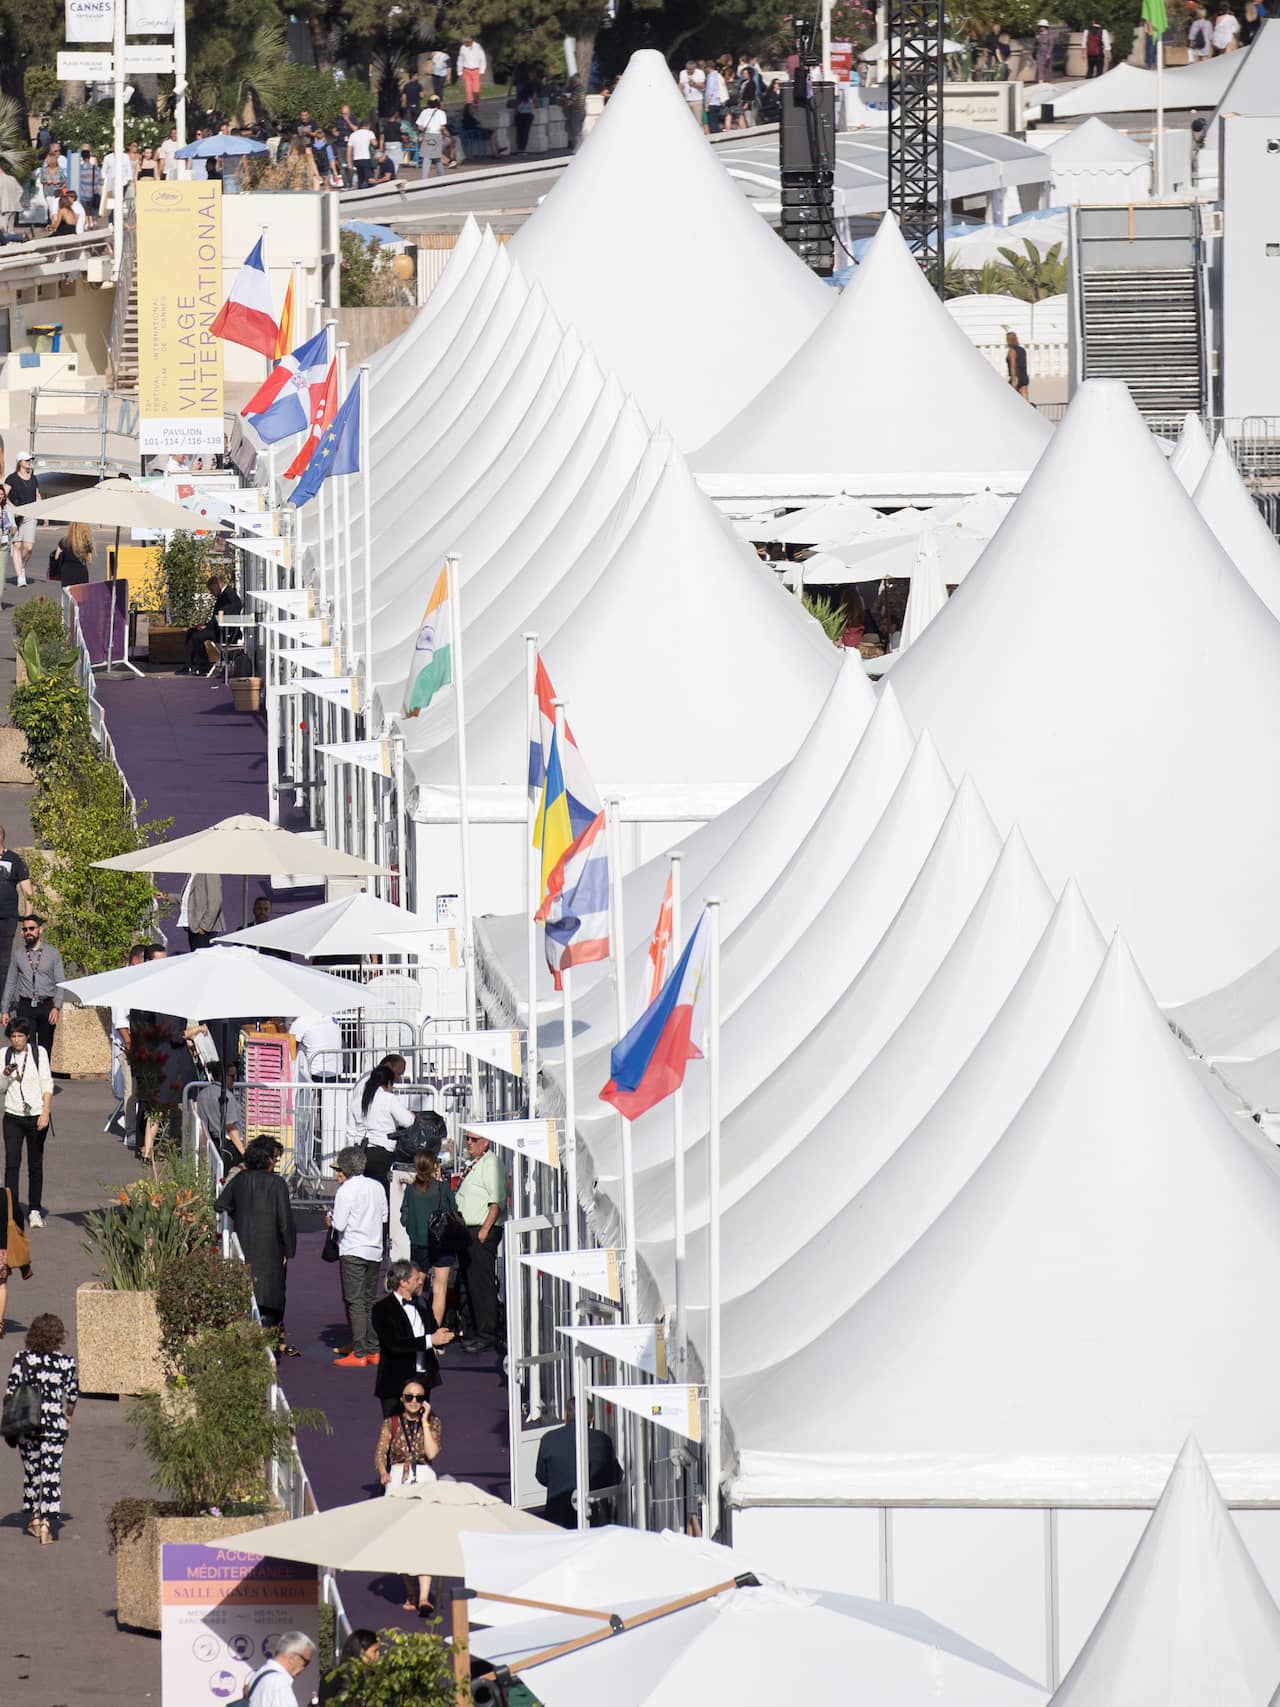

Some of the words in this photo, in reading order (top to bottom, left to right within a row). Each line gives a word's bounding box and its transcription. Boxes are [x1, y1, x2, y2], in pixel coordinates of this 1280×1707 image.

[70, 2, 112, 12] CANNES
[198, 187, 218, 412] INTERNATIONAL
[177, 295, 197, 411] VILLAGE
[163, 428, 203, 436] PAVILION
[143, 437, 180, 446] 101-114
[174, 1587, 213, 1598] SALLE
[262, 1585, 305, 1598] VARDA
